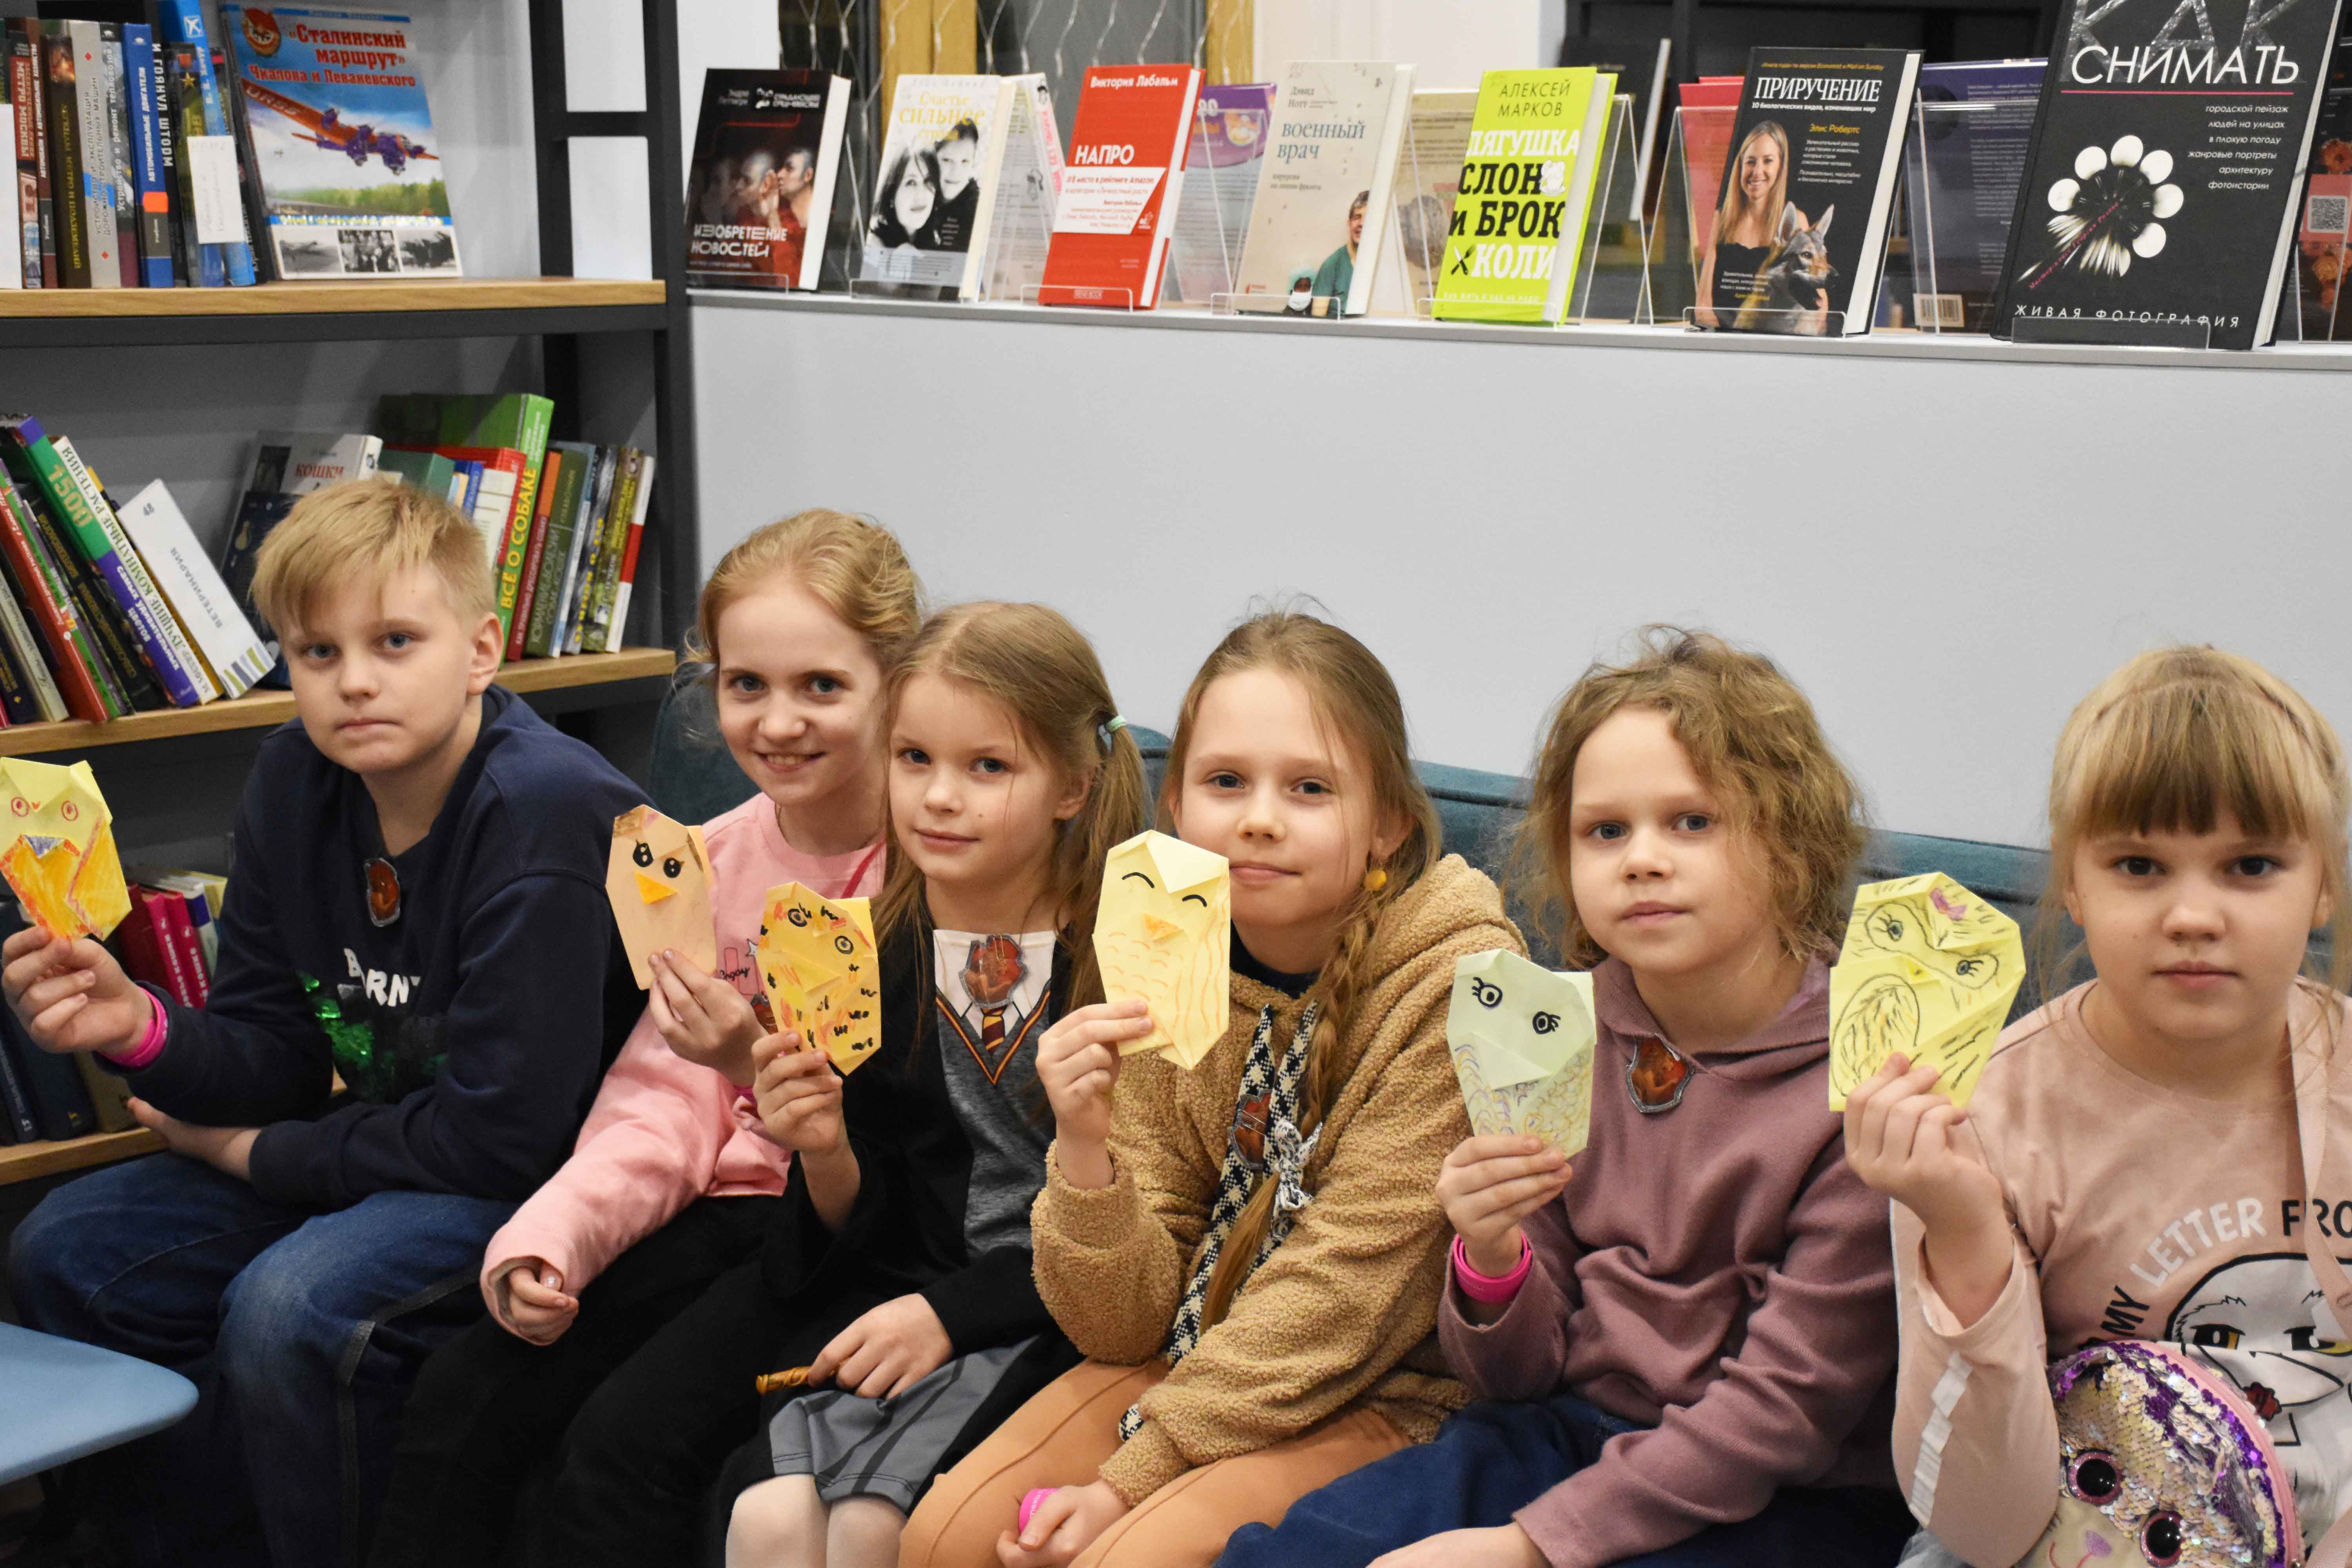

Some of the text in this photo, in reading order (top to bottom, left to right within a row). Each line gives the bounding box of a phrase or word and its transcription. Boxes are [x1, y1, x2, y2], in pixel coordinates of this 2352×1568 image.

[289, 23, 407, 49] «Сталинский
[316, 47, 405, 70] маршрут»
[2071, 45, 2299, 85] СНИМАТЬ
[249, 64, 416, 87] Чкалова и Леваневского
[1091, 74, 1178, 89] Виктория Лабальм
[90, 77, 100, 111] МАШИН
[920, 91, 969, 105] Счастье
[1290, 86, 1315, 96] Дэвид
[1499, 80, 1571, 97] АЛЕКСЕЙ
[1754, 77, 1882, 102] ПРИРУЧЕНИЕ
[15, 61, 29, 156] МЕТРО МОСКВЫ
[151, 42, 174, 167] И ГРЯНУЛ ШТОРМ
[1498, 102, 1562, 117] МАРКОВ
[2206, 105, 2288, 114] городской пейзаж
[83, 91, 96, 160] ЭКСПЛУАТАЦИЯ
[110, 107, 122, 142] ремонт
[136, 66, 158, 182] АВТОМОБИЛЬНЫЕ ДВИГАТЕЛИ
[1281, 120, 1365, 139] военный
[1809, 123, 1861, 134] Элис Робертс
[2208, 120, 2236, 129] людей
[2250, 137, 2281, 145] погоду
[1075, 145, 1134, 165] НАПРО
[1277, 144, 1319, 164] врач
[2188, 151, 2277, 160] жанровые портреты
[1458, 163, 1543, 195] СЛОН
[2219, 167, 2273, 175] архитектуру
[2208, 181, 2269, 190] фотоистории
[91, 176, 102, 235] УСТРОЙСТВО
[1475, 201, 1565, 239] БРОК
[693, 224, 788, 242] ИЗОБРЕТЕНИЕ
[691, 240, 769, 258] НОВОСТЕЙ
[2015, 304, 2239, 328] ЖИВАЯ ФОТОГРАФИЯ
[61, 446, 106, 514] РАСТЕНИЯ
[295, 464, 345, 479] КОШКИ
[47, 462, 93, 528] 1500
[511, 468, 537, 545] СОБАКЕ
[100, 515, 154, 595] КОМНАТНЫЕ
[508, 551, 521, 567] О
[167, 546, 225, 629] ВЕТЕРИНАРИЯ
[500, 573, 517, 608] ВСЕ
[115, 564, 182, 672] самых удивительных
[126, 605, 153, 642] цветов
[148, 594, 187, 650] ЛУЧШИЕ
[2101, 1286, 2150, 1336] MY
[2129, 1197, 2267, 1288] LETTER
